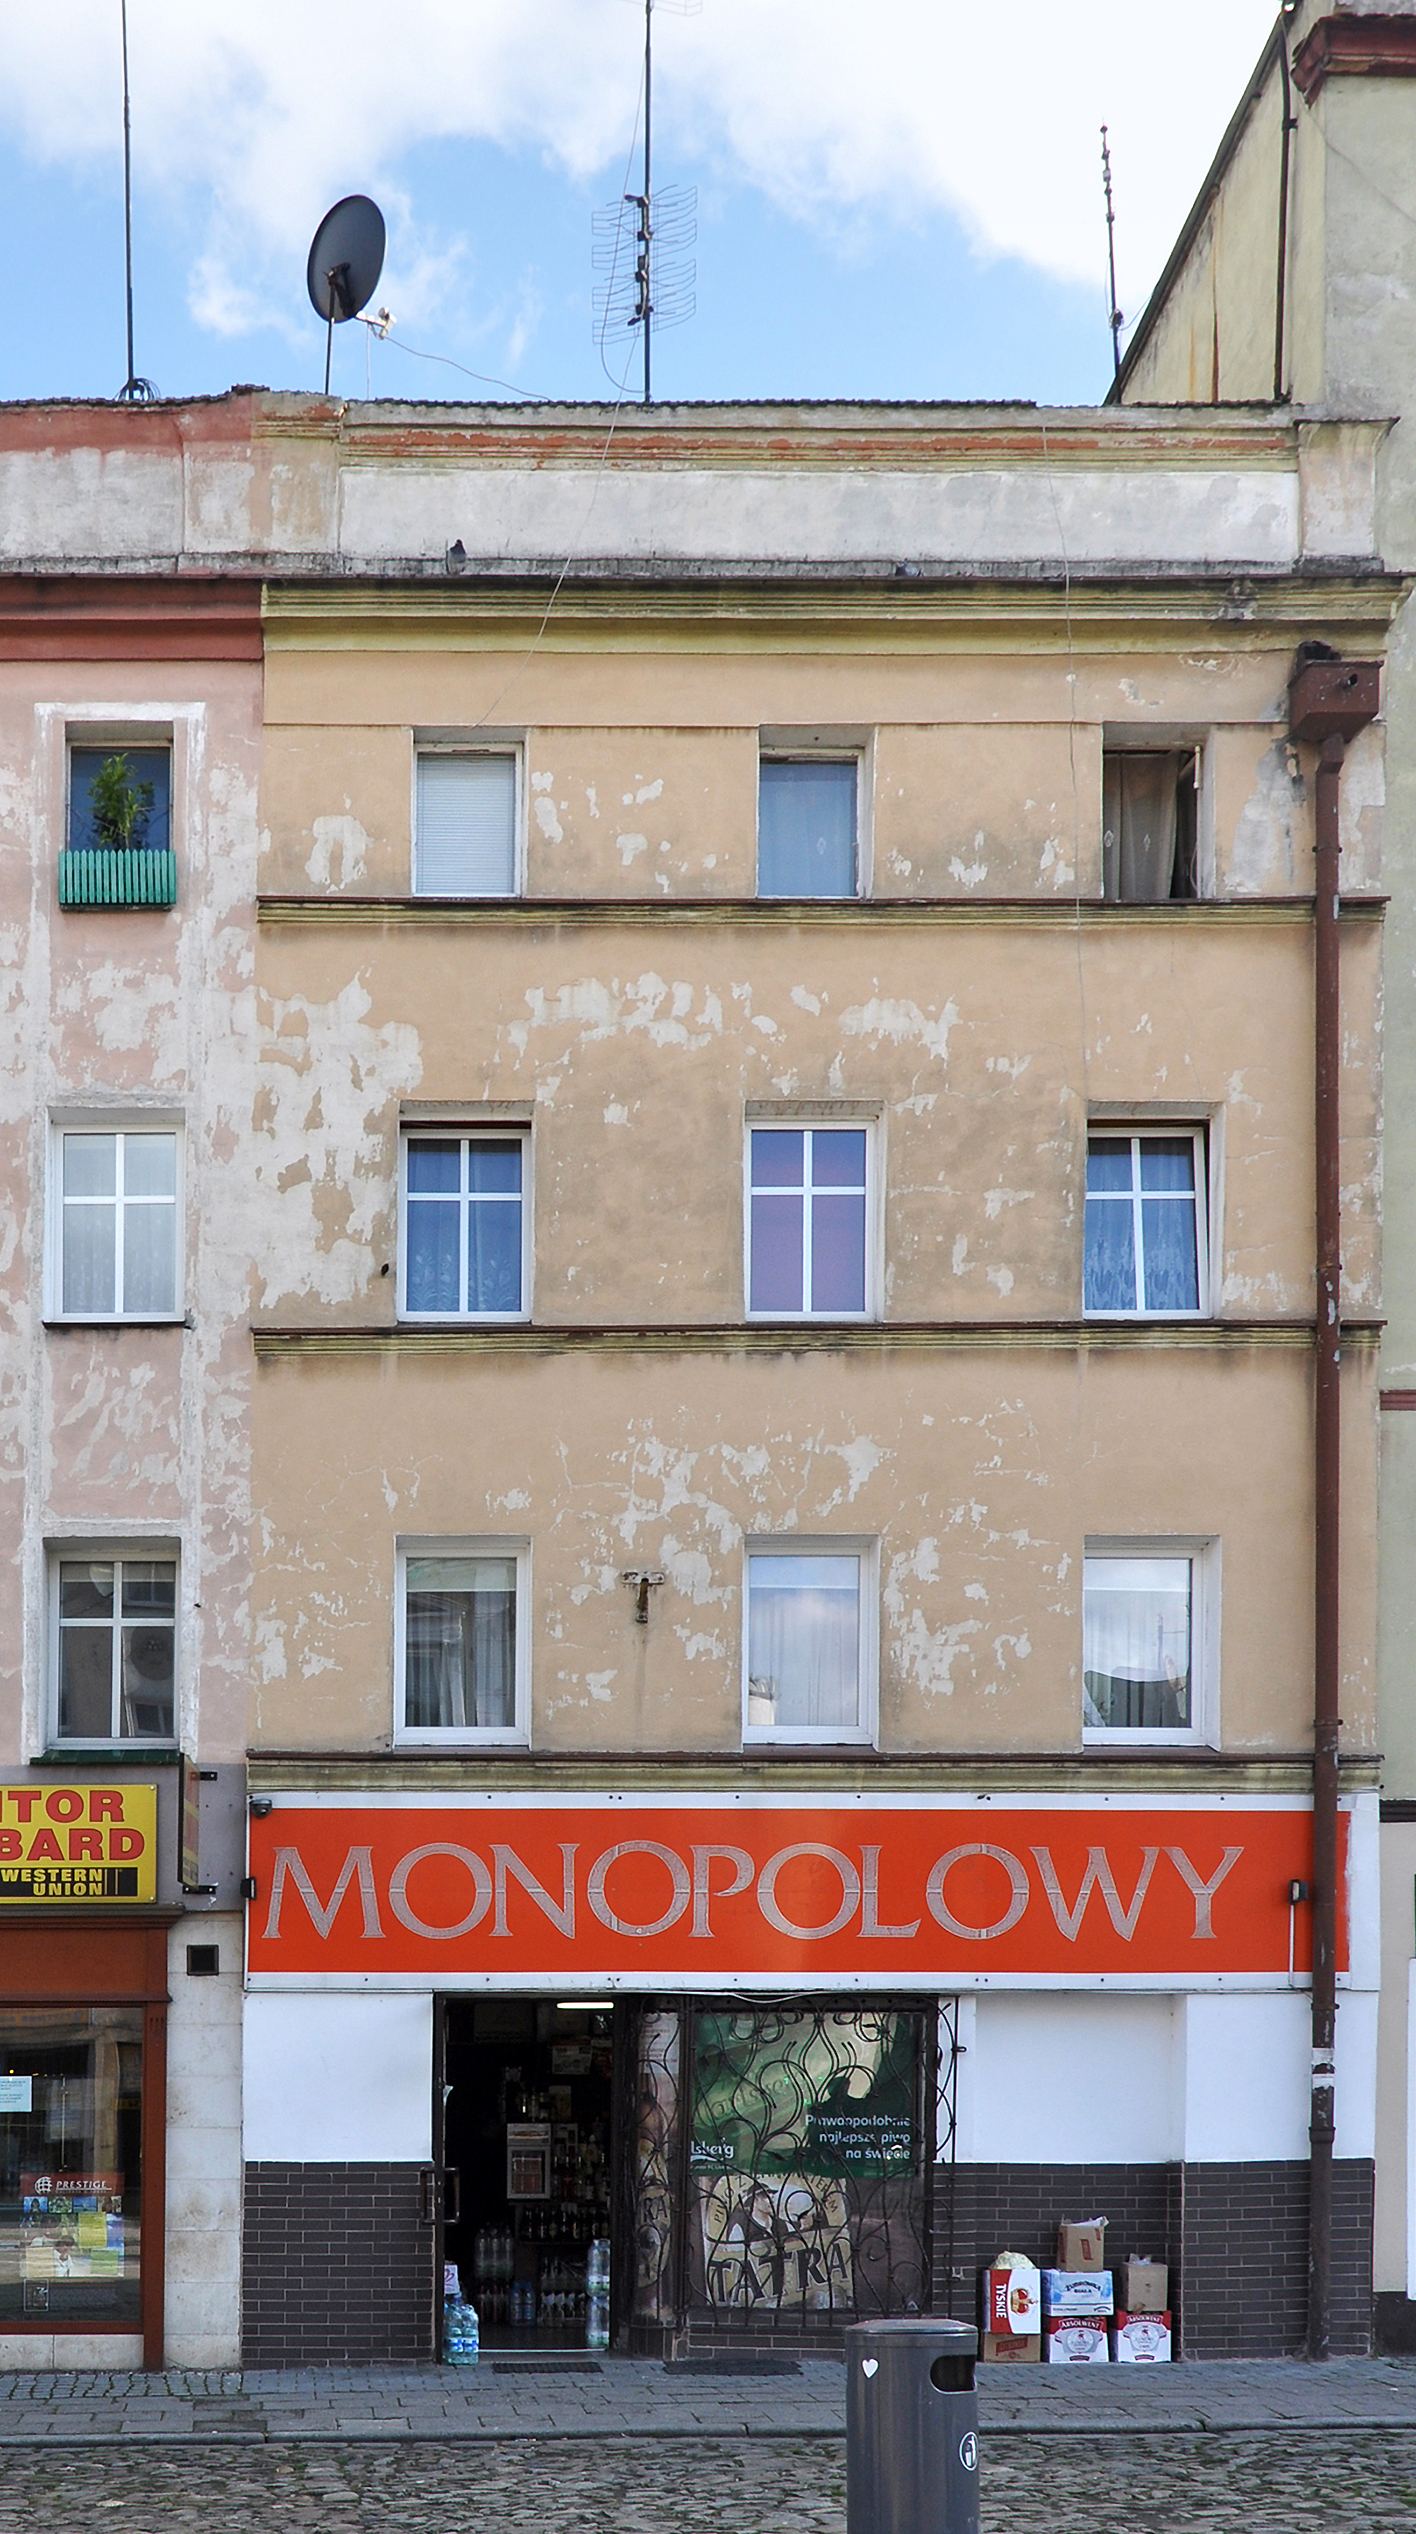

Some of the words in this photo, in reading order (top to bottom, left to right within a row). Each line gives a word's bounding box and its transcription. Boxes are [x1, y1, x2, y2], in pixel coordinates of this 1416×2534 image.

[1, 1869, 102, 1882] WESTERN
[33, 1883, 102, 1895] UNION
[261, 1840, 1244, 1942] MONOPOLOWY
[881, 2131, 911, 2145] piwo
[846, 2149, 861, 2159] na
[56, 2180, 107, 2189] PRESTIGE
[709, 2243, 849, 2304] TATRA
[995, 2283, 1007, 2319] TYSKIE
